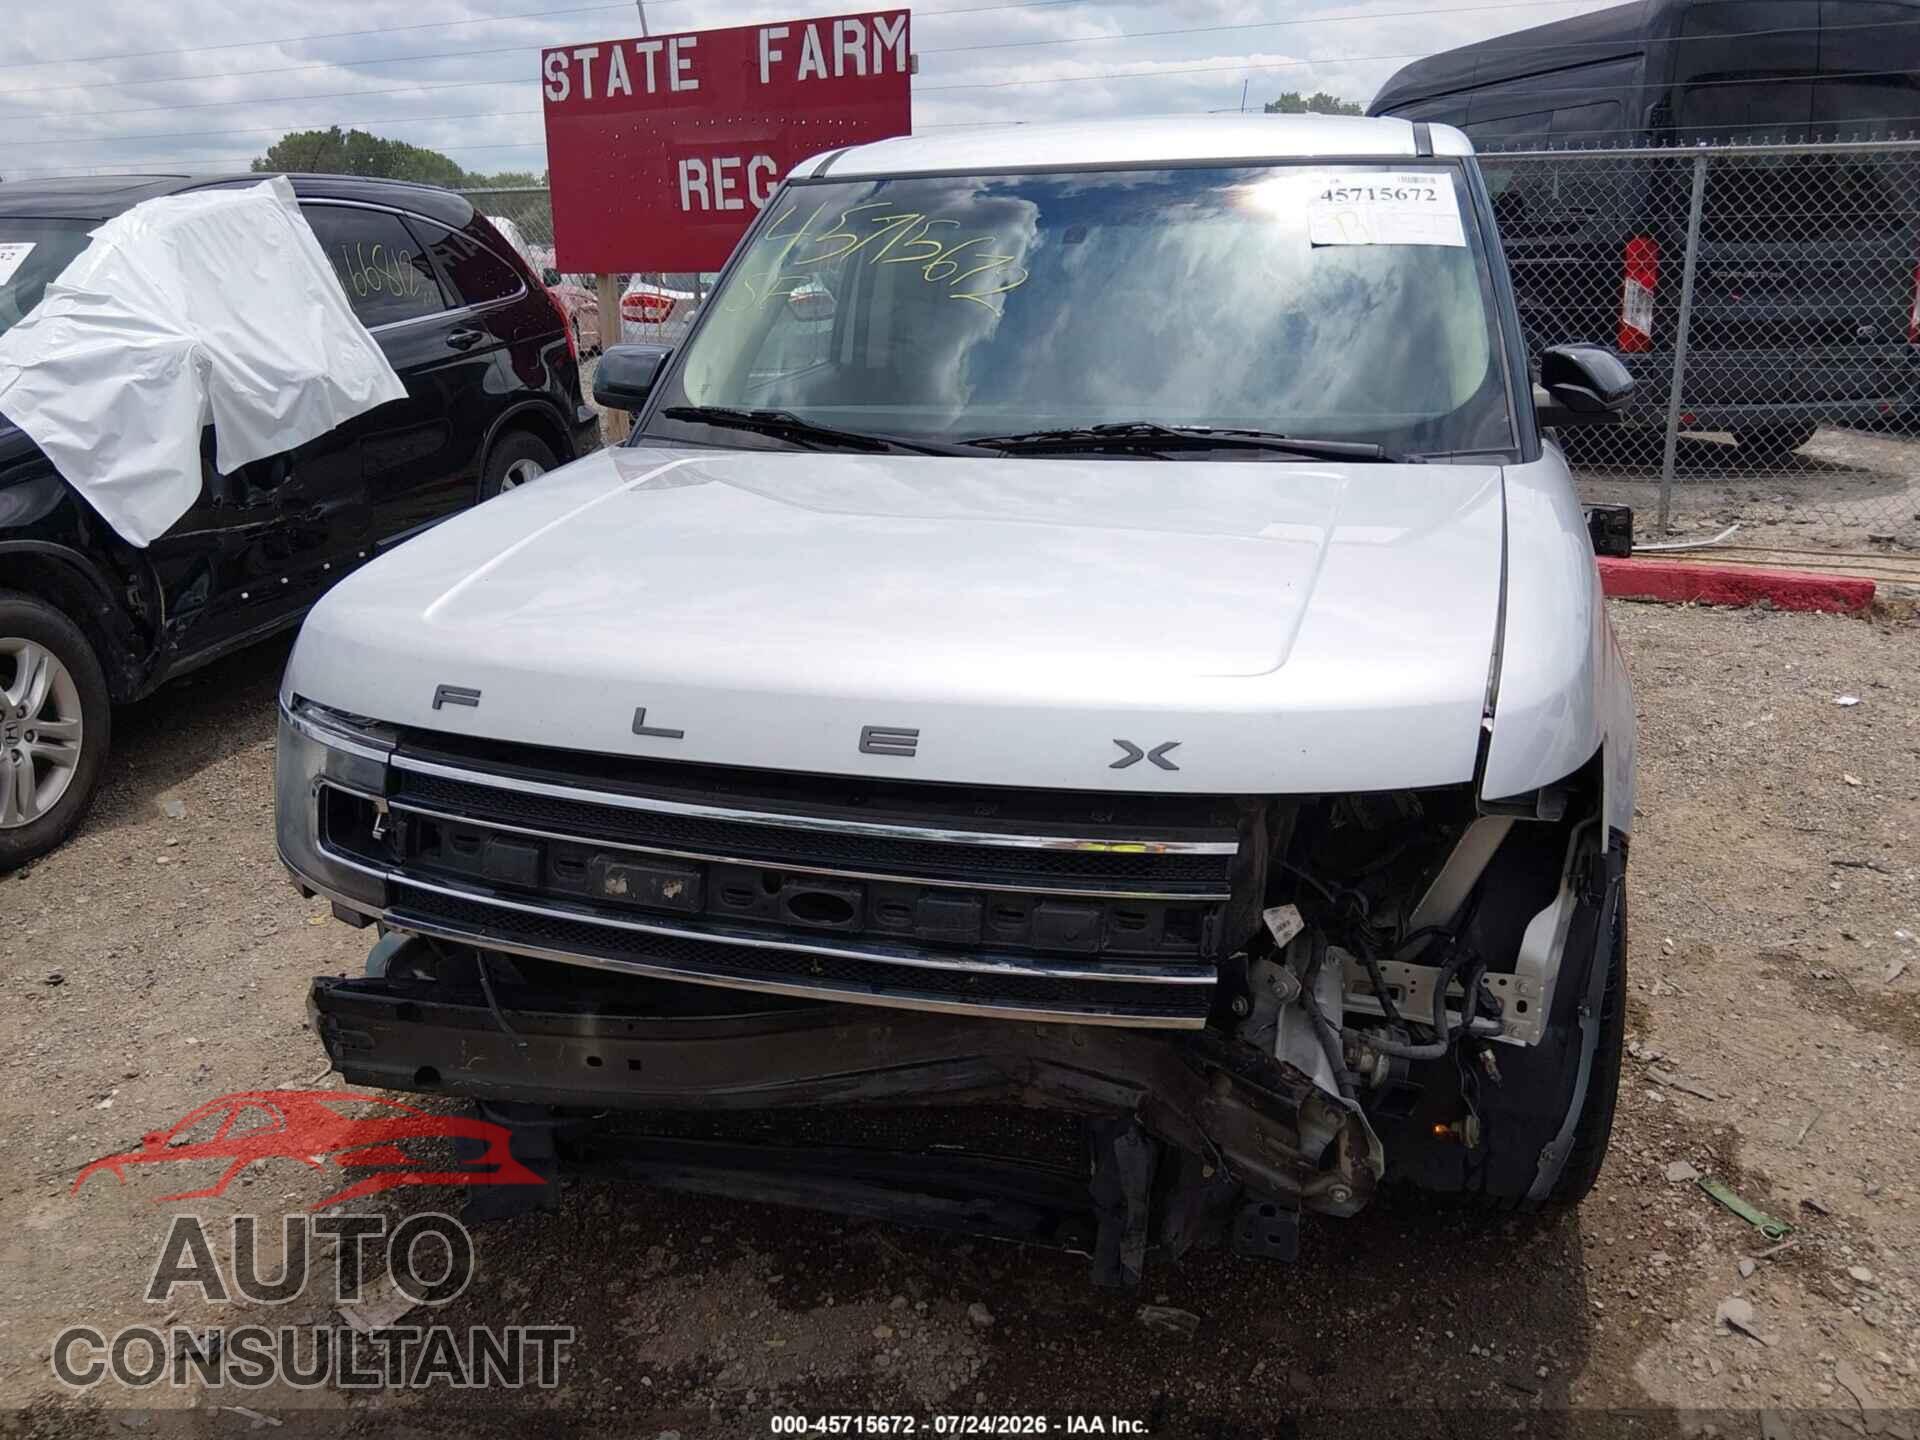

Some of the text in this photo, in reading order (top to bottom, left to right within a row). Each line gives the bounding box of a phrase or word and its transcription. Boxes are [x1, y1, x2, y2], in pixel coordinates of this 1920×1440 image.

[543, 14, 907, 102] STATE FARM
[1319, 187, 1438, 202] 45715672
[432, 683, 1183, 771] FLEX
